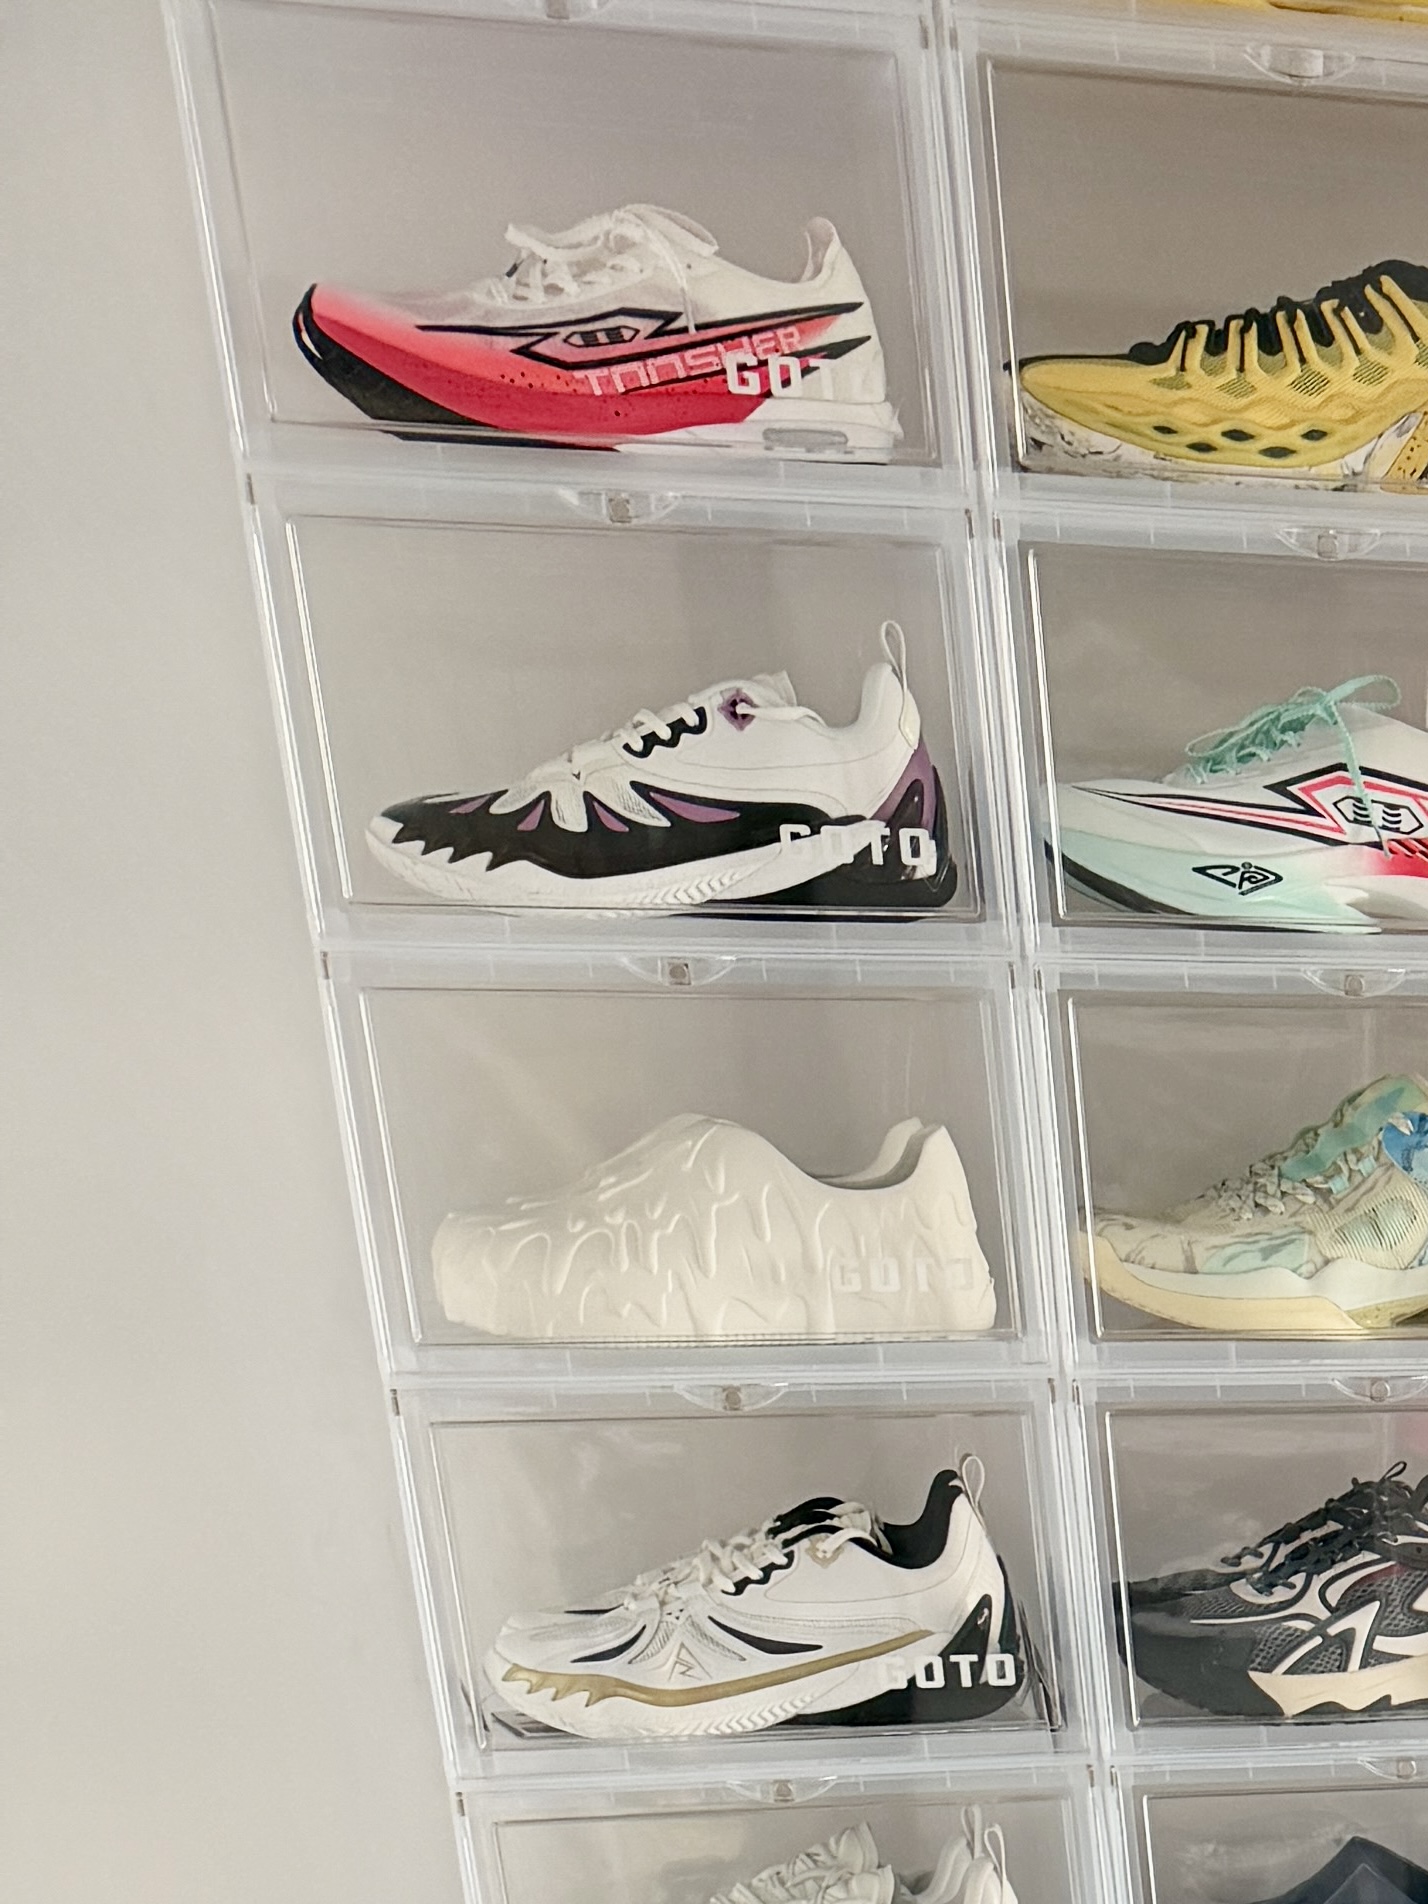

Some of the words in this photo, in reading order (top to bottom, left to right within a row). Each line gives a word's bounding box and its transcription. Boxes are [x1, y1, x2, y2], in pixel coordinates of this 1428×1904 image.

[727, 352, 872, 402] GOT
[779, 824, 934, 871] GOTO
[874, 1654, 1018, 1690] GOTO
